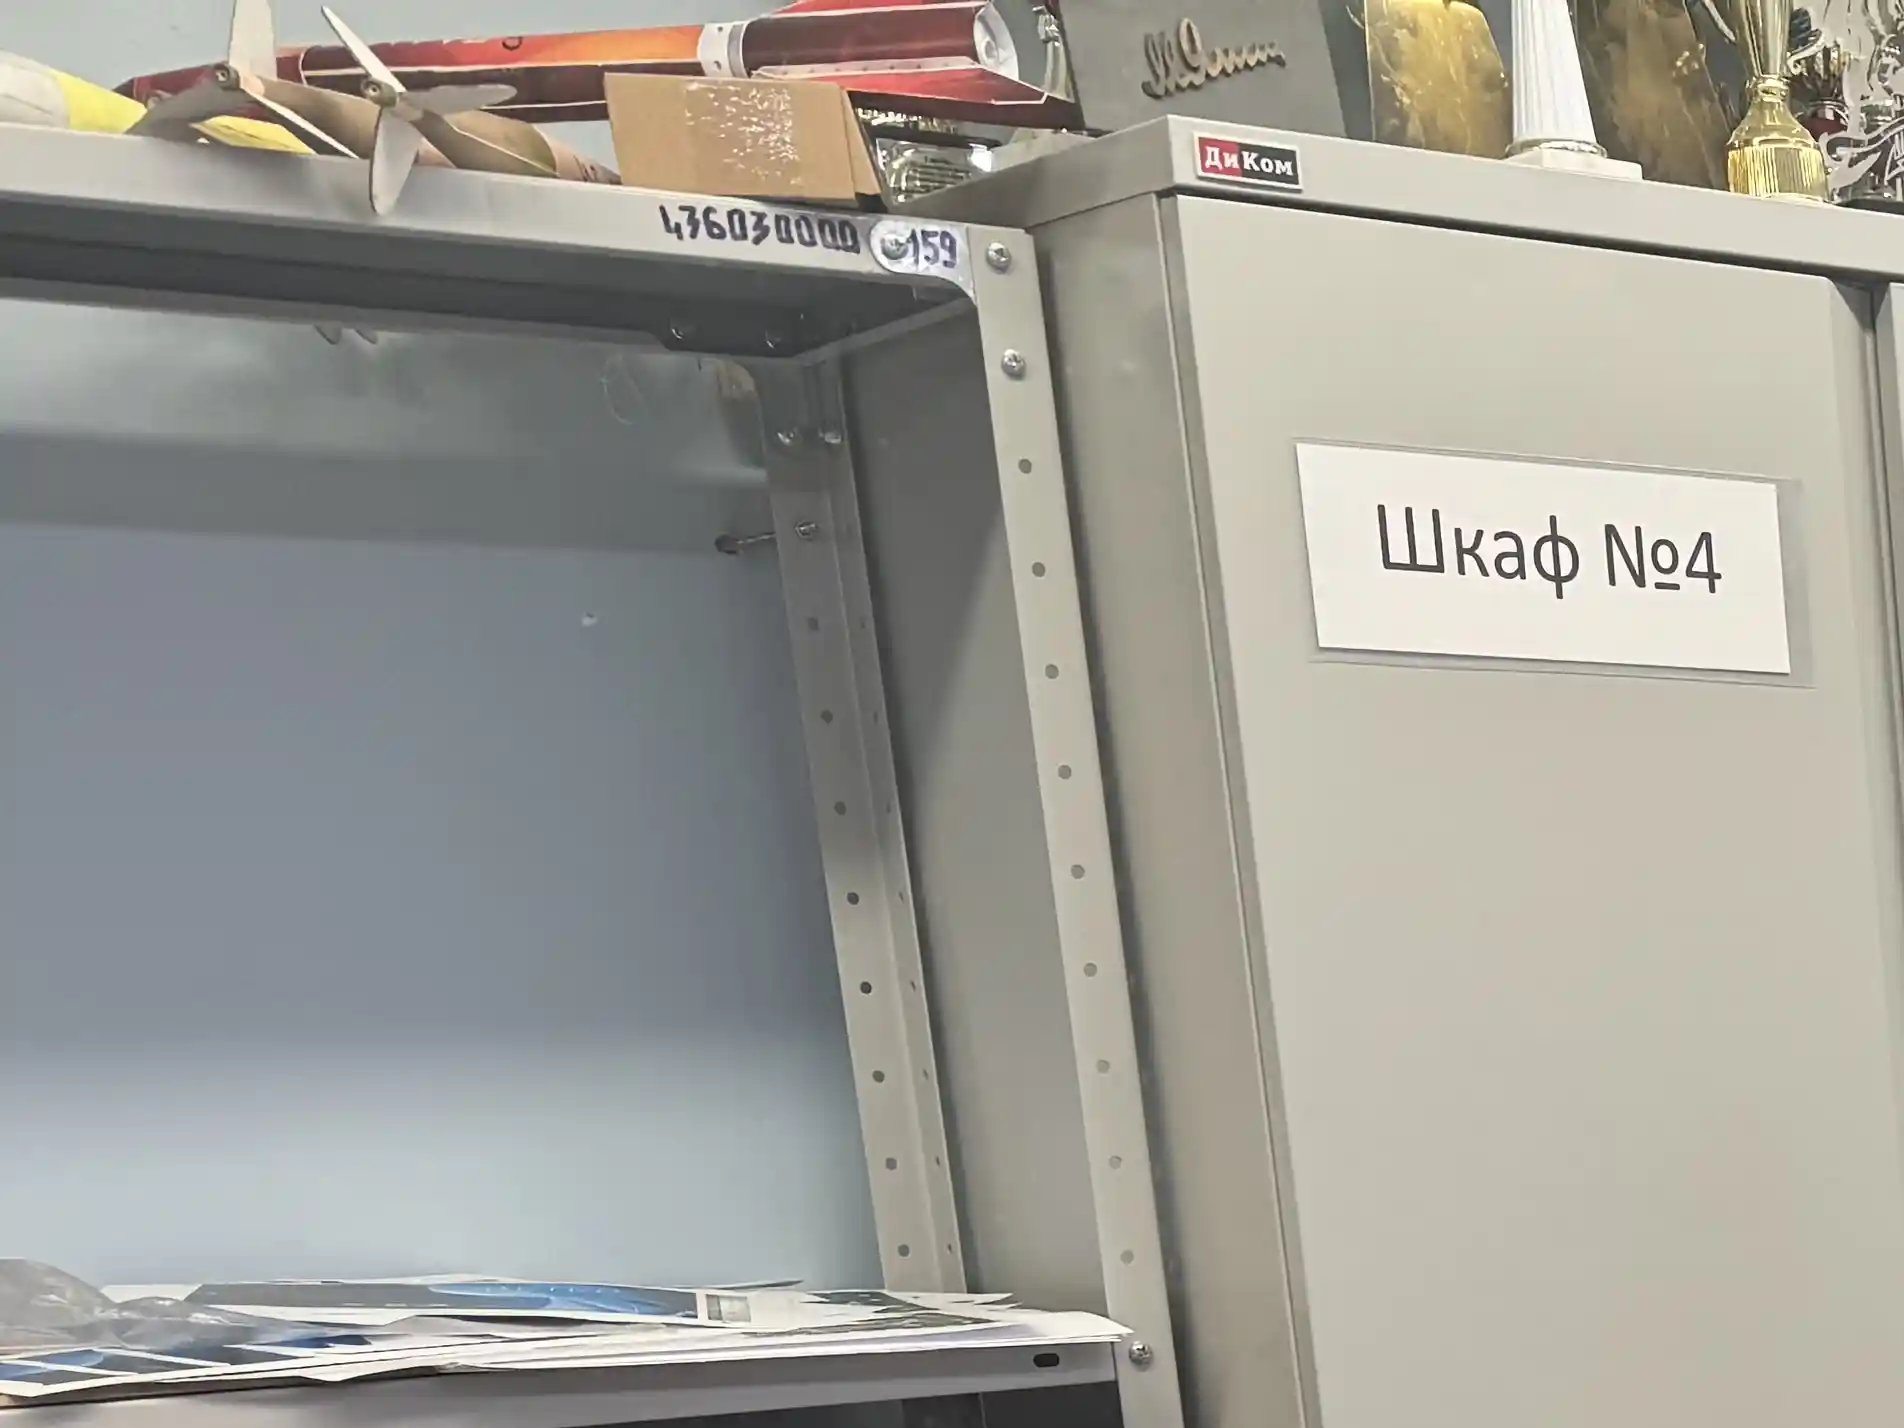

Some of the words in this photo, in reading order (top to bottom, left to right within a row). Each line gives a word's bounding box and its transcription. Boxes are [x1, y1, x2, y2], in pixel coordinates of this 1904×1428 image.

[1204, 145, 1294, 176] ДиКом
[1377, 504, 1580, 600] Шкаф
[1604, 523, 1723, 594] №4
